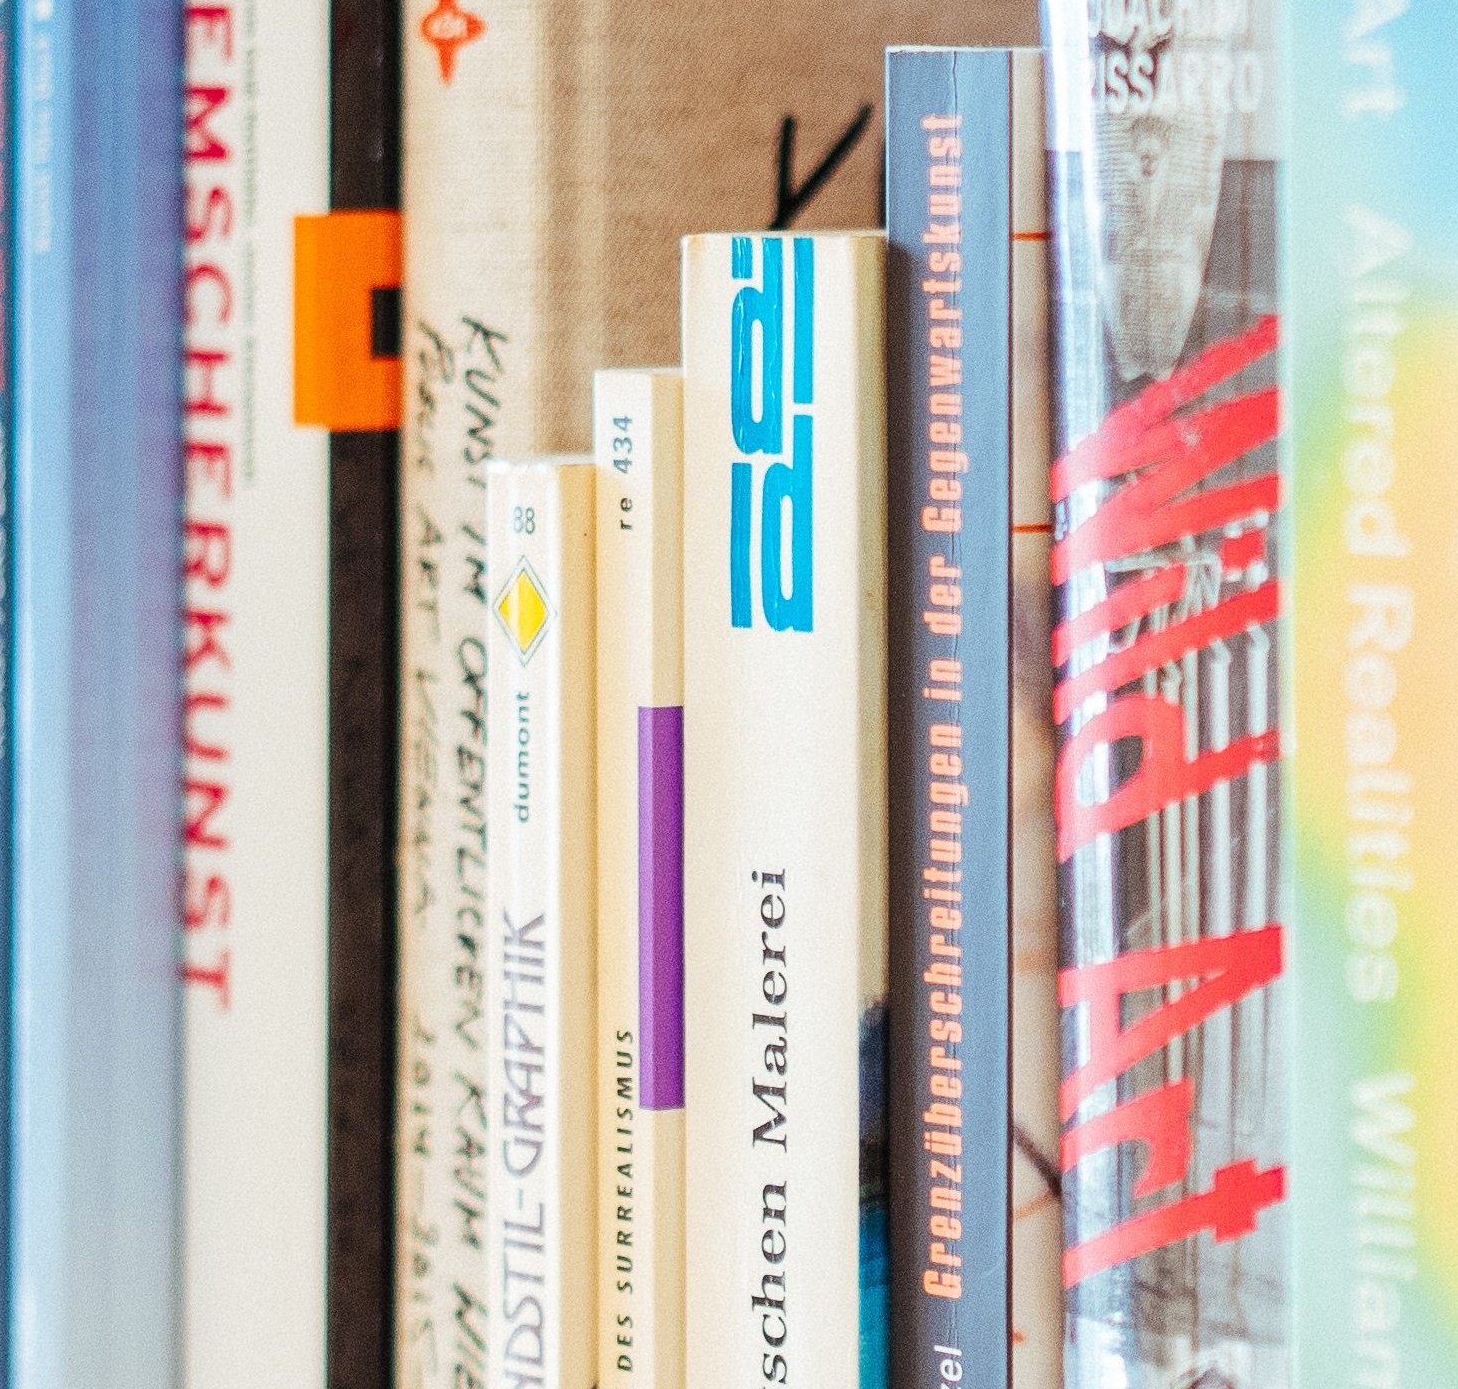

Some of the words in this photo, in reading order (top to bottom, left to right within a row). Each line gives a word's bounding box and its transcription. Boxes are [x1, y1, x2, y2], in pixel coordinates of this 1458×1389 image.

[610, 413, 633, 475] 434
[920, 113, 971, 532] Gegenwartskunst
[1341, 202, 1415, 558] Altered
[183, 2, 236, 1012] EMSCHERKUNST
[462, 525, 488, 606] IM
[922, 554, 964, 636] der
[512, 691, 532, 825] dumont
[921, 658, 964, 702] in
[1342, 581, 1416, 1005] Realities
[750, 868, 788, 1154] Malerei
[921, 723, 970, 1299] Grenzüberschreitungen
[1060, 922, 1286, 1290] Art
[615, 1029, 634, 1295] SURREALISMUS
[616, 1314, 634, 1372] DES
